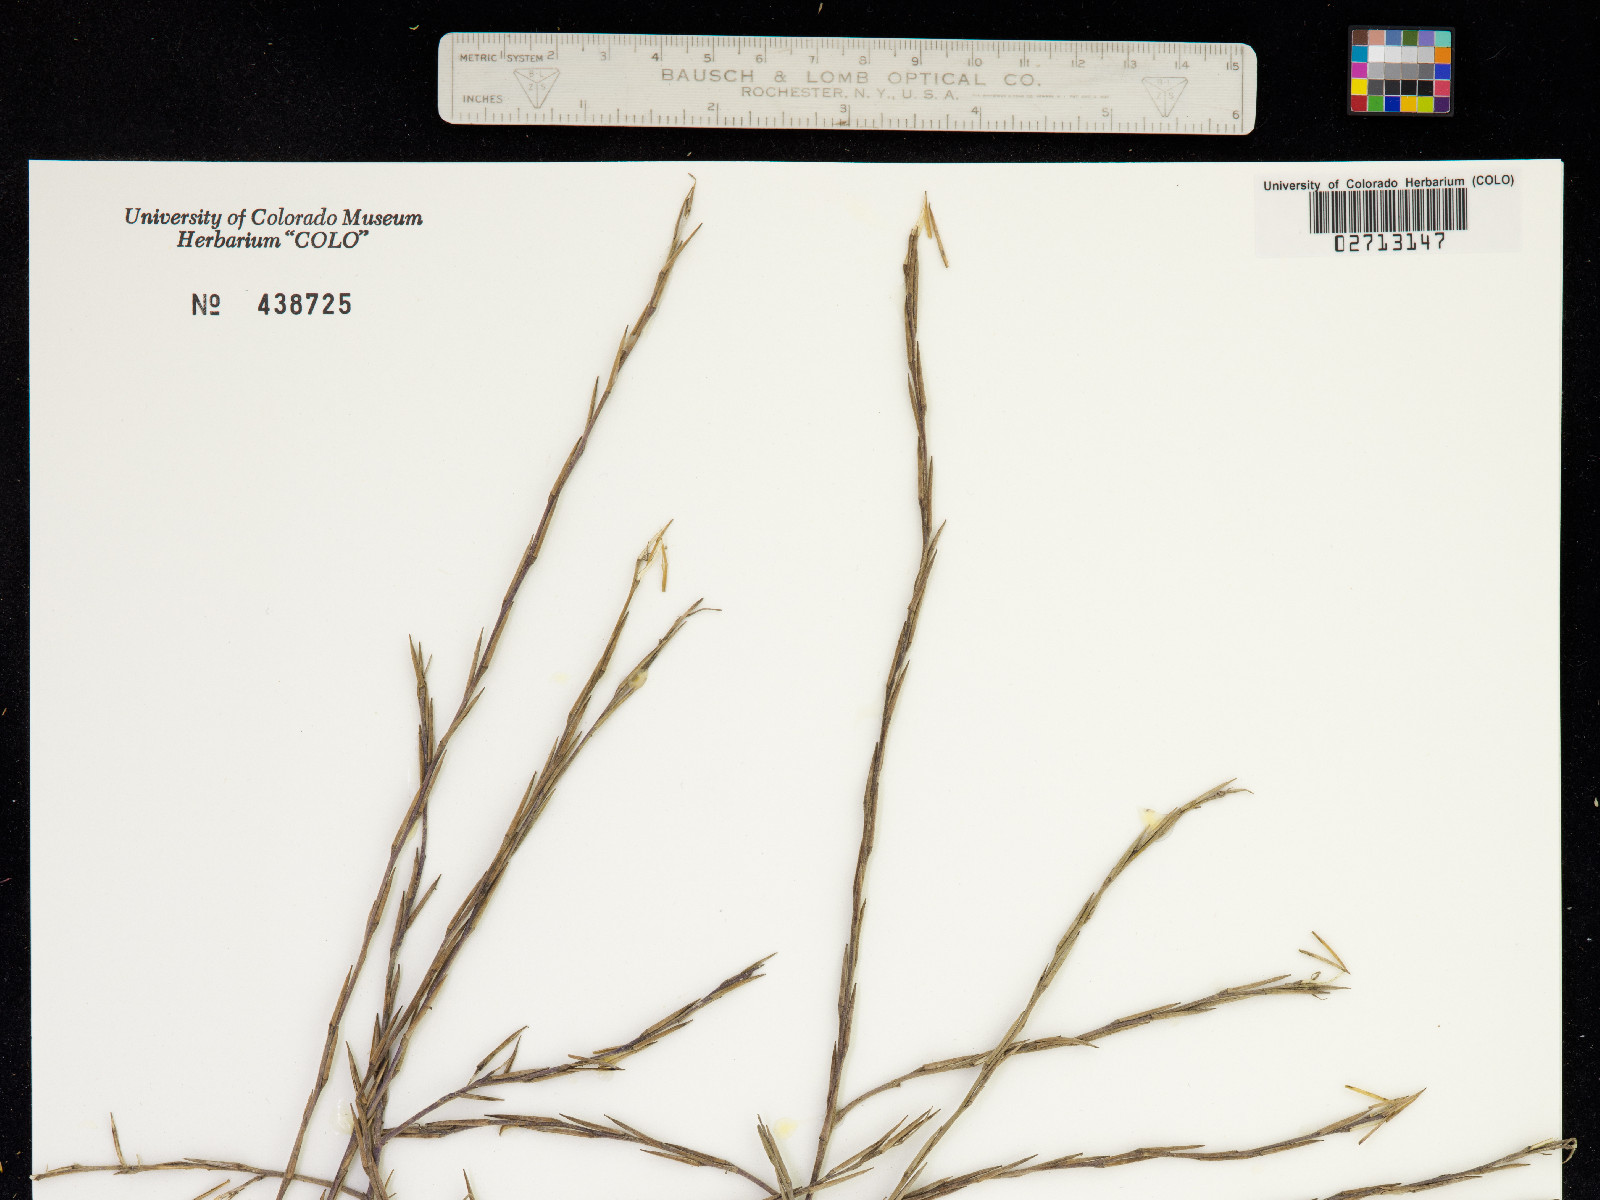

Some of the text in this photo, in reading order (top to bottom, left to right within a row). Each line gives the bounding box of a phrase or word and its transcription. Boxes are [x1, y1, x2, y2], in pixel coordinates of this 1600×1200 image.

[459, 53, 544, 63] METRIC SYSTEM
[546, 50, 555, 60] 2
[599, 51, 607, 62] 3
[651, 52, 659, 62] 4
[703, 53, 712, 63] 5
[755, 54, 763, 63] 6
[808, 55, 816, 64] 7
[858, 55, 867, 65] 8
[911, 57, 919, 66] 9
[661, 68, 1041, 87] BAUSCH & LOMB OPTICAL CO.
[462, 94, 503, 104] INCHES
[707, 102, 715, 111] 2
[839, 104, 847, 113] 3
[971, 106, 979, 114] 4
[1101, 108, 1110, 117] 5
[1232, 110, 1240, 119] 6
[1263, 174, 1515, 193] University of Colorado Herbarium (COLO)
[124, 207, 424, 231] University of Colorado Museum
[176, 230, 281, 249] Herbarium
[1334, 231, 1446, 253] 02713147
[257, 292, 352, 316] 438725
